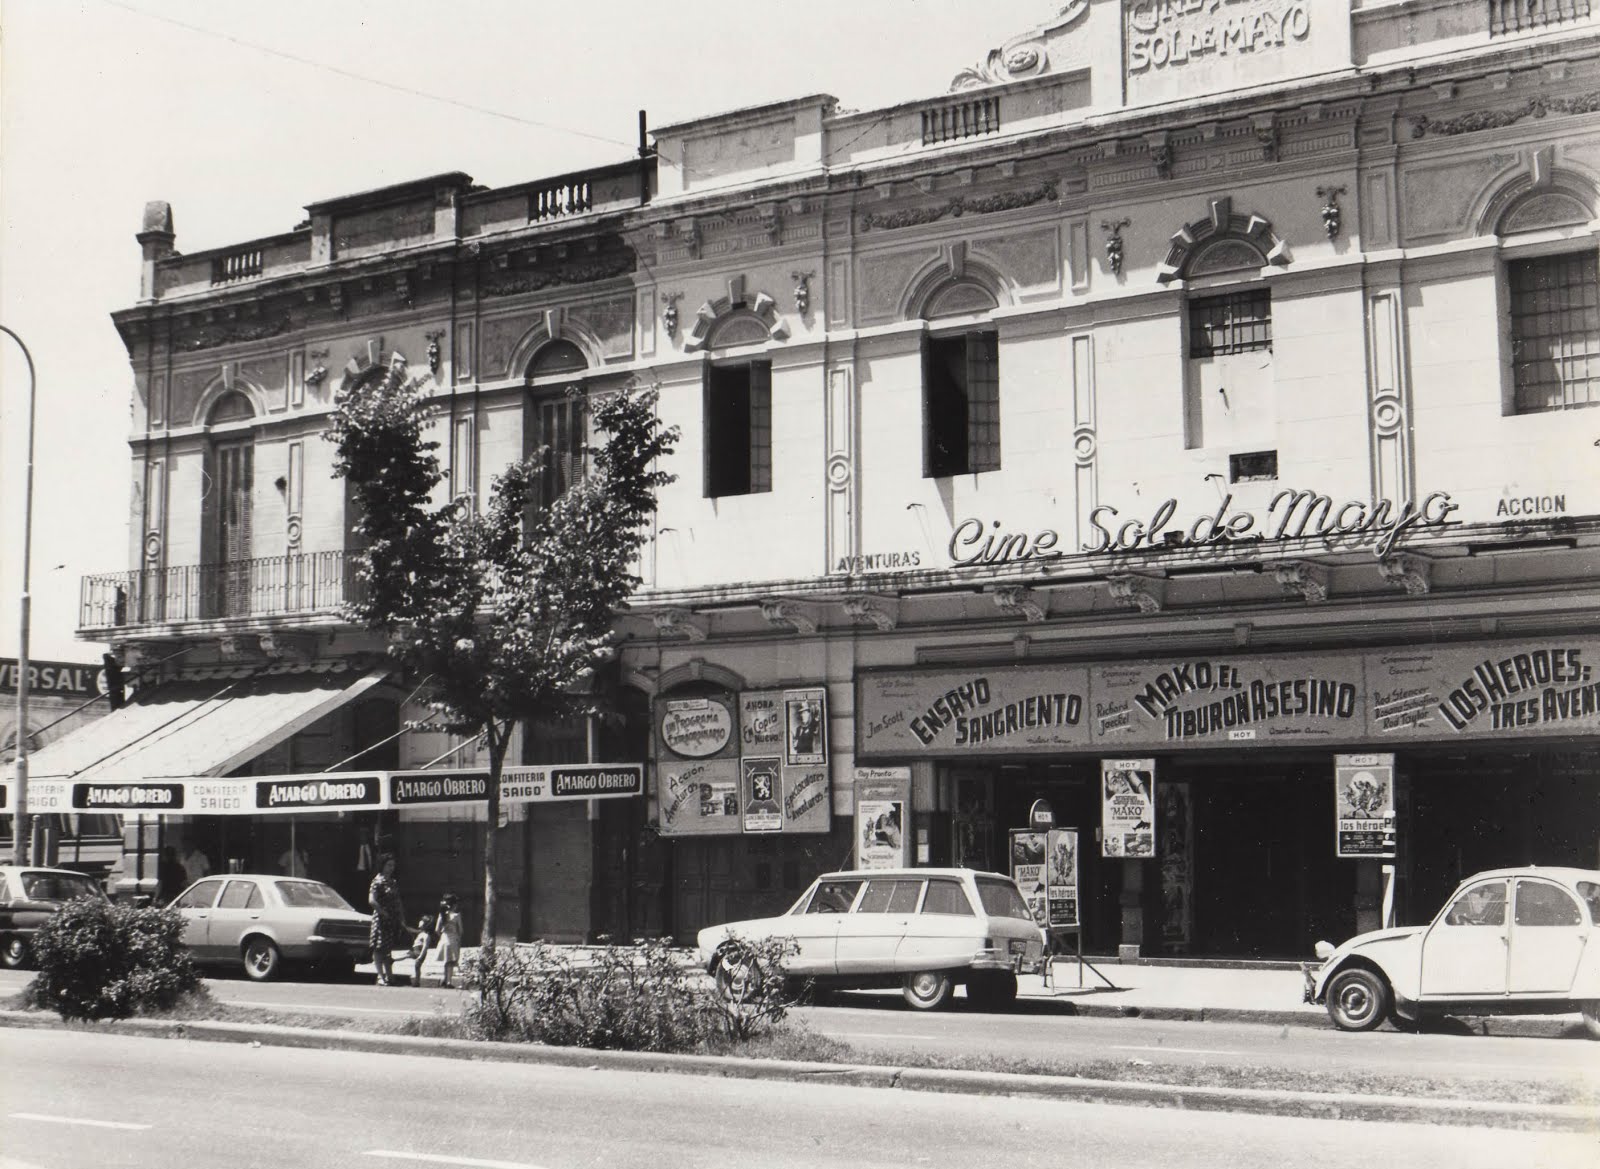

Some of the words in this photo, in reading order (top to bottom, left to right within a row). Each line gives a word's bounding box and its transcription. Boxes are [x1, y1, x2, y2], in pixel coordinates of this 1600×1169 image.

[1496, 494, 1566, 516] ACCION
[949, 519, 1063, 566] Cine
[1082, 498, 1182, 552] Sol
[1184, 493, 1261, 545] de
[1267, 488, 1459, 557] Mayo
[837, 551, 921, 571] AVENTURAS
[1135, 661, 1218, 718] MAKO,
[1219, 665, 1242, 688] EL
[910, 678, 991, 745] ENSAYO
[1096, 700, 1129, 718] Richard
[1163, 690, 1250, 738] TIBURON
[1250, 679, 1356, 721] ASESINO
[1439, 678, 1487, 731] LOS
[1491, 698, 1538, 729] TRES
[1542, 682, 1600, 722] AVEN
[955, 694, 1083, 745] SANGRIENTO
[1400, 710, 1430, 728] Taylor
[1233, 731, 1251, 739] HOY
[499, 772, 546, 783] ONFITERIA
[556, 773, 597, 795] AMARGO
[597, 772, 636, 789] OBRERO
[86, 786, 129, 806] AMARGO
[131, 787, 172, 803] OBRERO
[269, 784, 318, 806] AMARGO
[319, 782, 366, 800] OBRERO
[397, 780, 442, 802] AMARGO
[443, 778, 486, 796] OBRERO
[28, 797, 58, 808] AIGO
[200, 797, 241, 809] SAIGO
[1340, 820, 1354, 830] los
[1356, 820, 1384, 831] héroe
